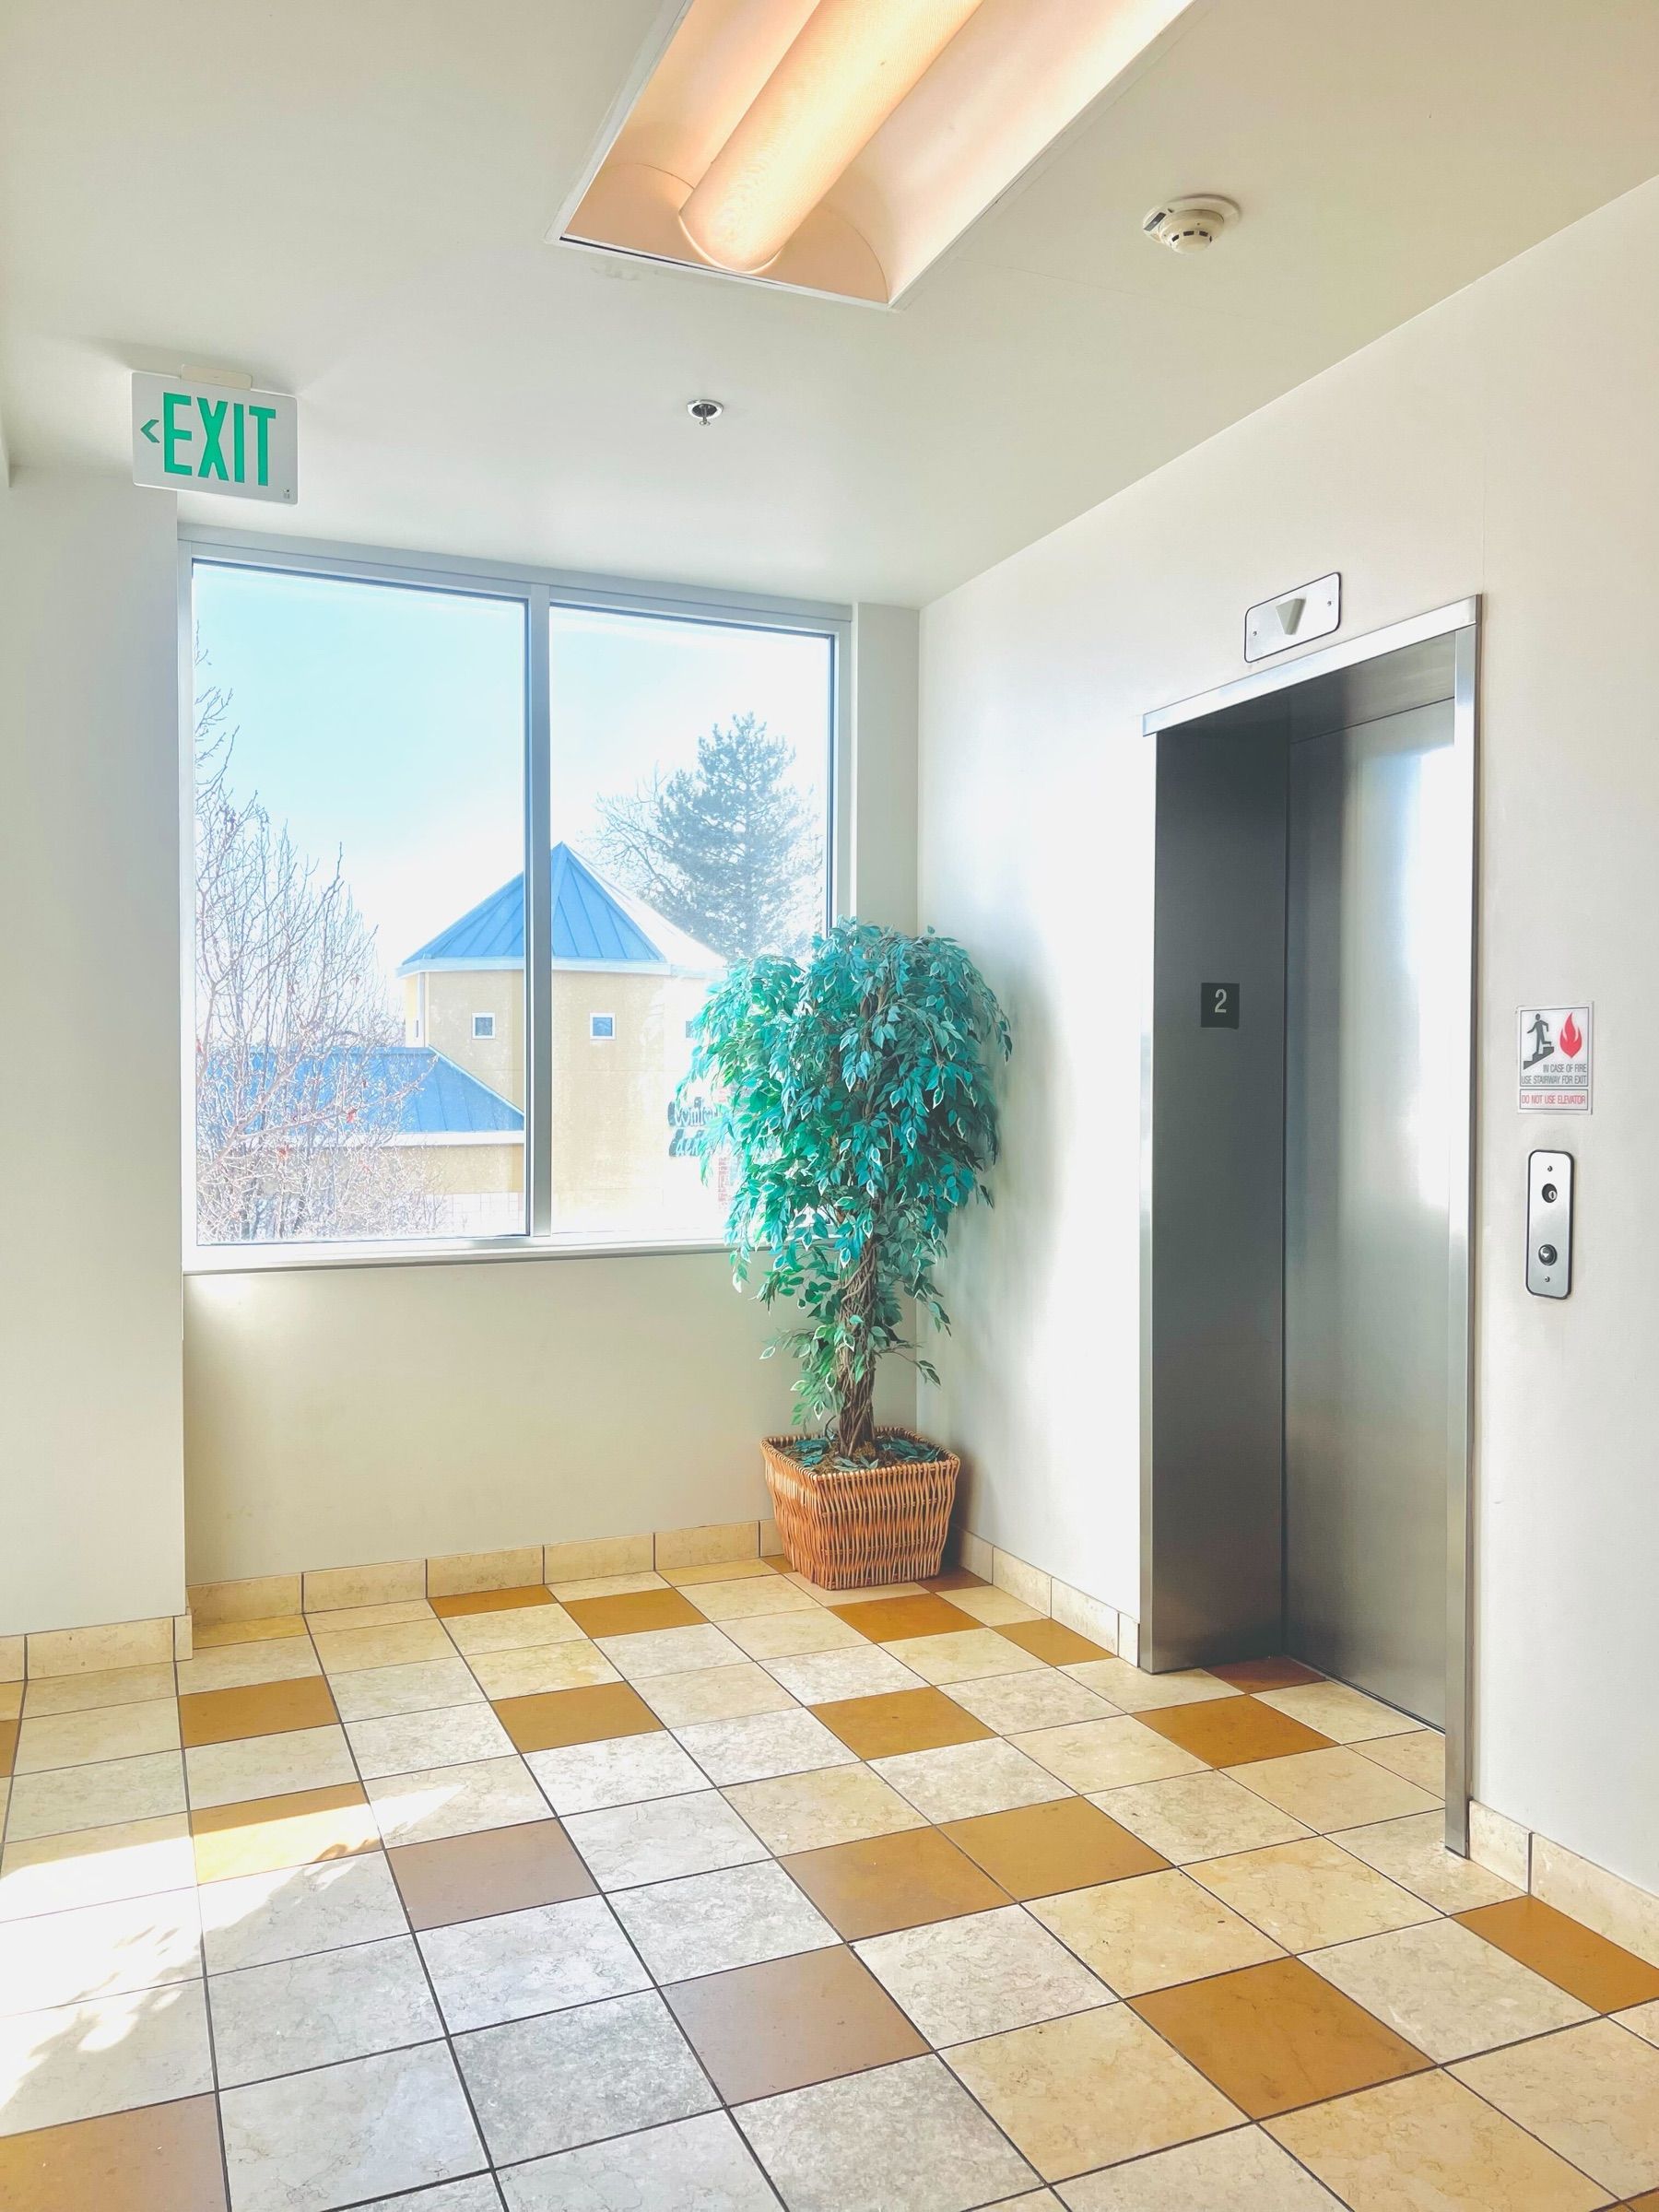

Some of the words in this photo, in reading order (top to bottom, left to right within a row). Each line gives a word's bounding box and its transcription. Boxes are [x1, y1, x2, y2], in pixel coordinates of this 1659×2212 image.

[163, 392, 276, 487] EXIT
[1215, 988, 1227, 1013] 2
[1543, 1064, 1549, 1073] IN
[1550, 1064, 1565, 1073] CASE
[1566, 1064, 1575, 1073] OF
[1575, 1064, 1587, 1073] FIRE
[1522, 1076, 1532, 1085] USE
[1534, 1076, 1560, 1085] STAIRWAY
[1562, 1076, 1573, 1085] FOR
[1575, 1076, 1587, 1085] EXIT
[1522, 1094, 1530, 1104] DO
[1532, 1094, 1543, 1104] NOT
[1545, 1094, 1556, 1104] USE
[1558, 1094, 1586, 1105] ELEVATOR
